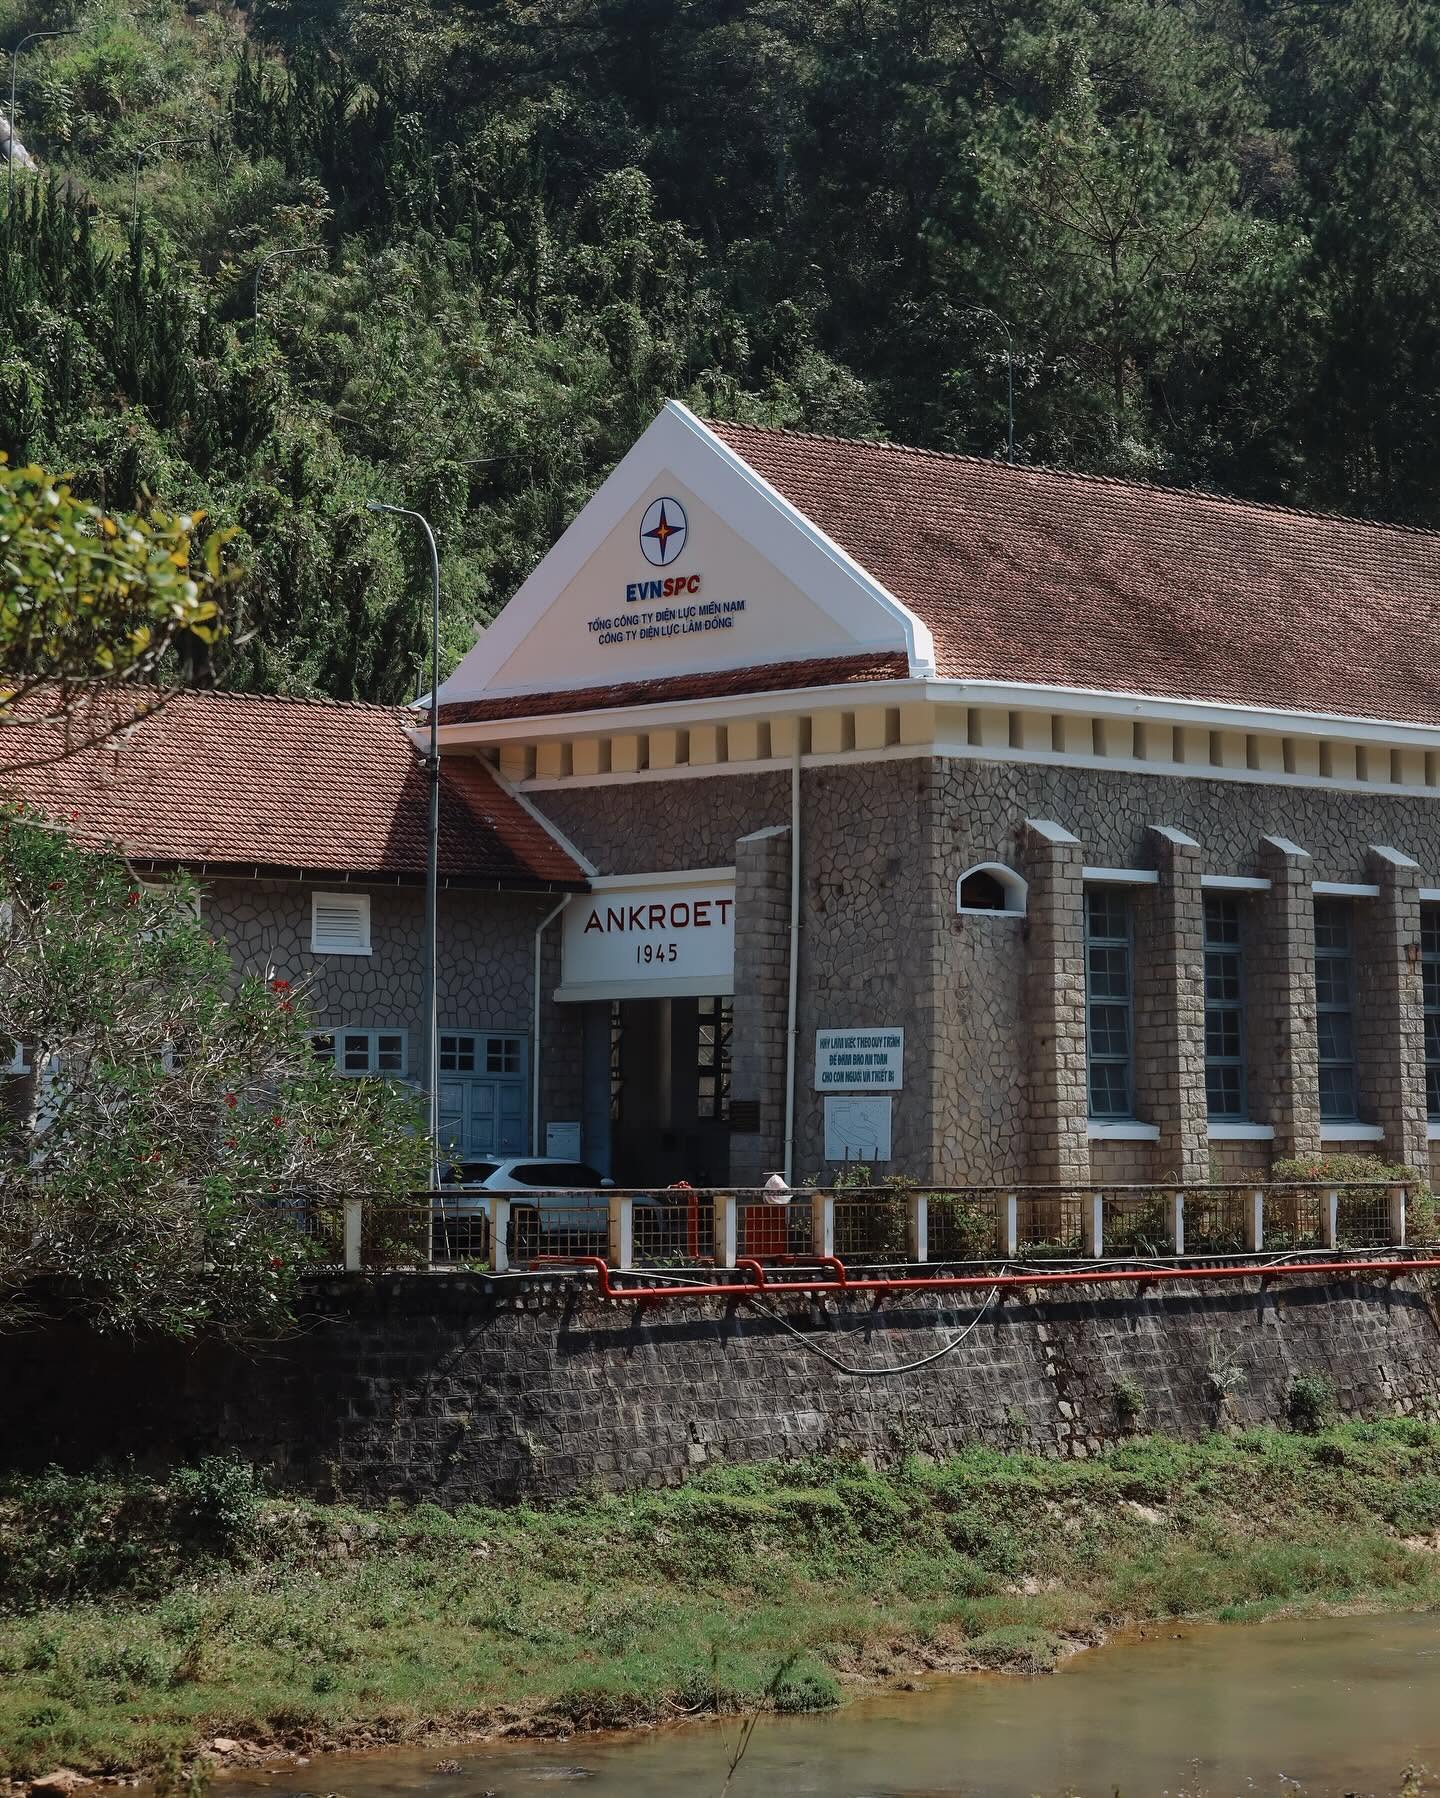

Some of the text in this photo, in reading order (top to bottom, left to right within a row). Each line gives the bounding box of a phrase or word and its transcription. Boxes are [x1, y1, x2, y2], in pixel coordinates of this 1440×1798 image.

[626, 575, 700, 602] EVNSPC
[613, 614, 639, 628] CÔNG
[641, 613, 653, 624] TY
[656, 608, 676, 623] ĐIỆN
[678, 606, 696, 620] LỰC
[723, 600, 745, 613] NAM
[598, 632, 623, 645] CÔNG
[625, 630, 637, 641] TY
[639, 625, 660, 641] ĐIỆN
[661, 623, 680, 638] LỰC
[682, 619, 702, 633] LÂM
[584, 899, 732, 933] ANKROET
[636, 943, 678, 964] 1945
